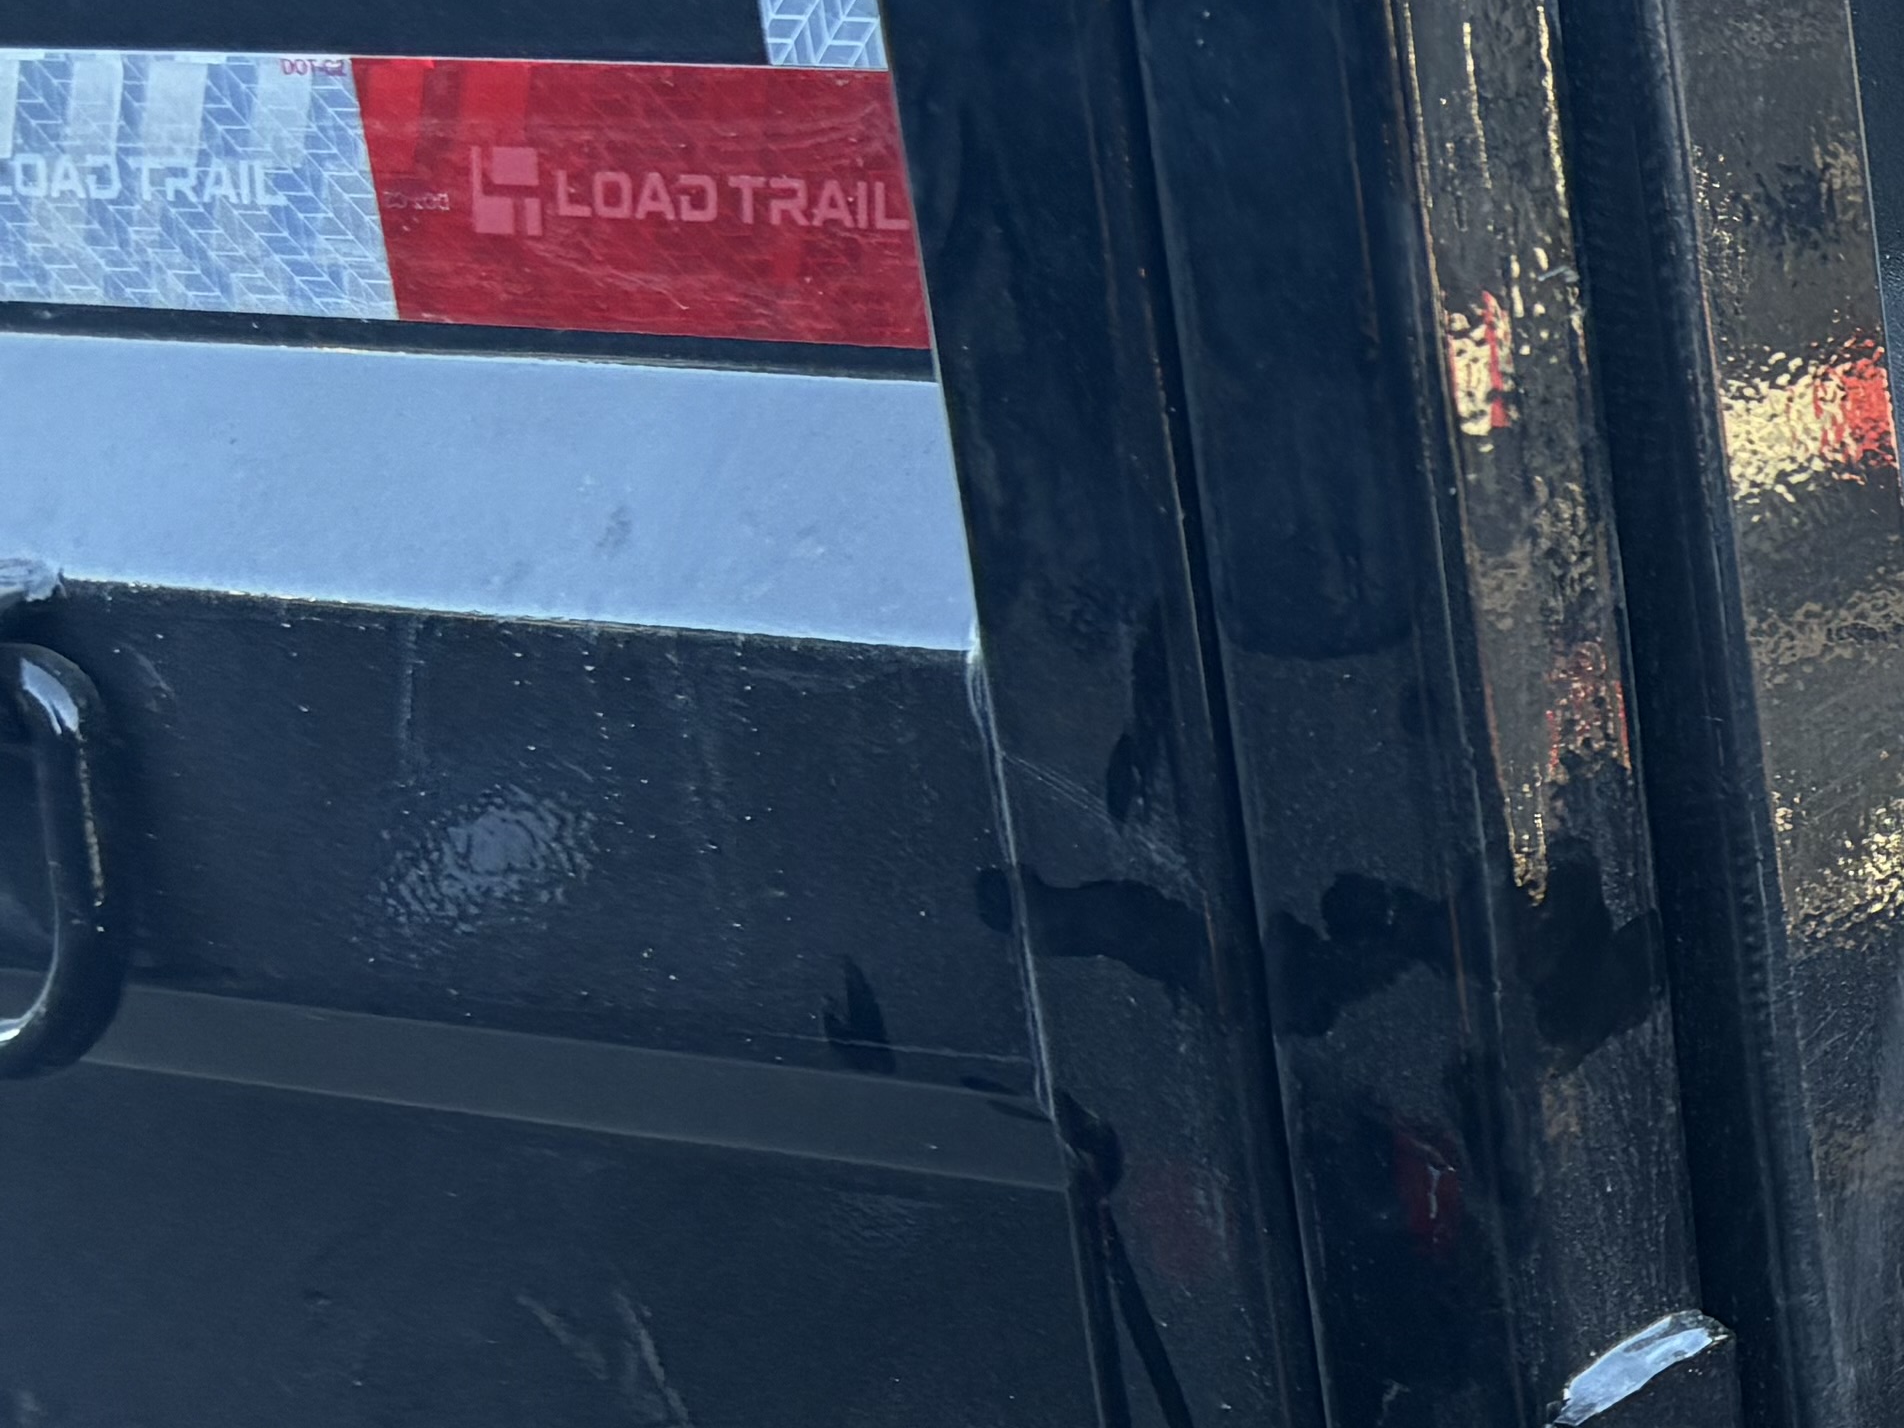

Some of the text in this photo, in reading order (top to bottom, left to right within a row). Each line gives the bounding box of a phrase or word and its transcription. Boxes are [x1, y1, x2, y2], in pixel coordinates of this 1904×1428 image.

[128, 155, 289, 206] TRAIL
[556, 170, 911, 231] LOAD TRAIL
